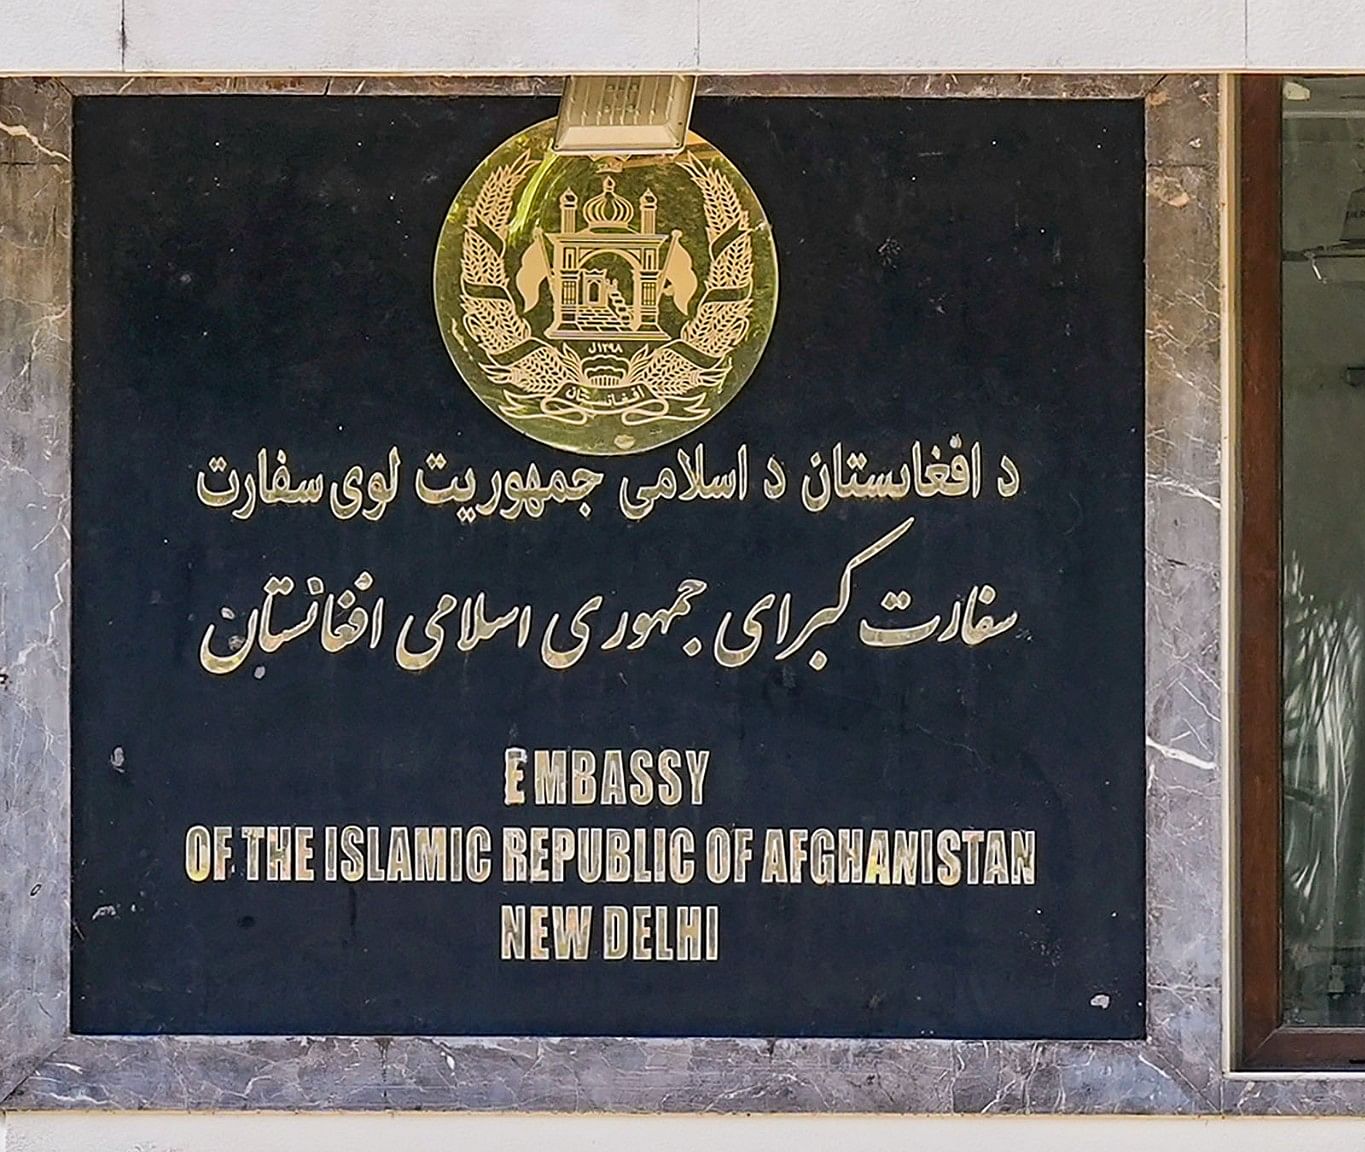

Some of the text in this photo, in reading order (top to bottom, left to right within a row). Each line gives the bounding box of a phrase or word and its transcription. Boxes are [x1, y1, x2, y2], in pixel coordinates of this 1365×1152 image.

[197, 446, 323, 520] سفارت
[763, 455, 787, 499] د
[801, 433, 981, 512] افغانستان
[997, 454, 1020, 497] د
[200, 571, 384, 674] افغانستان
[395, 592, 531, 671] اسلامی
[541, 579, 707, 670] جمهوری
[860, 584, 1018, 647] سفارت
[504, 747, 710, 806] EMBASSY
[184, 825, 1036, 885] OF THE ISLAMIC REPUBLIC OF AFGHANISTAN
[501, 905, 718, 962] NEW DELHI
